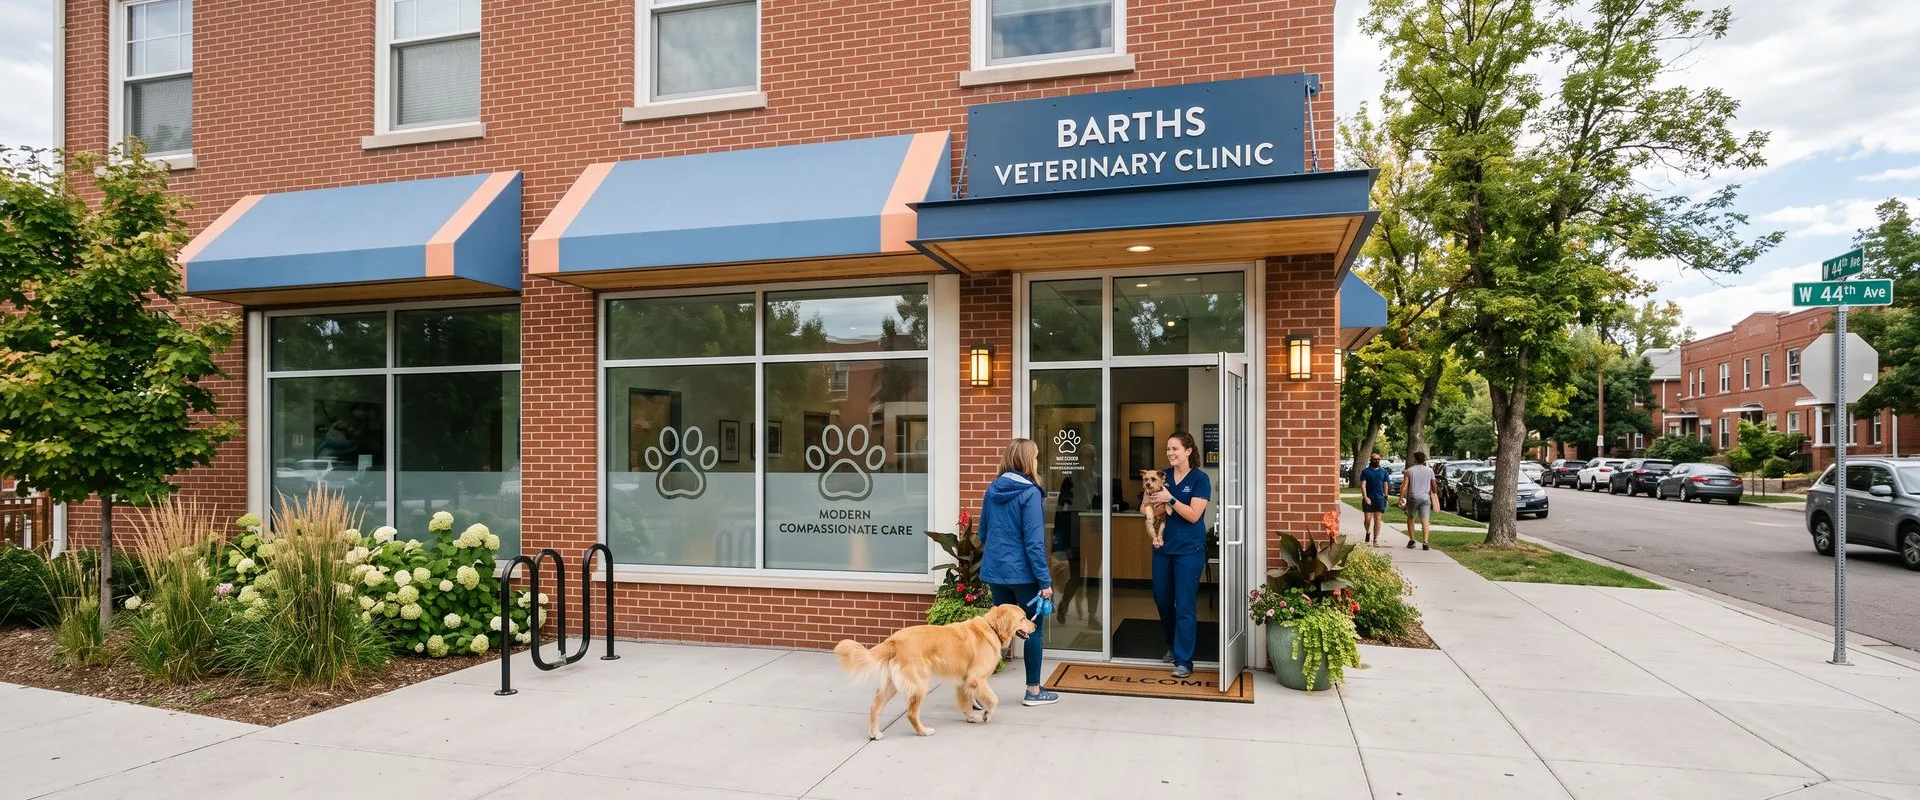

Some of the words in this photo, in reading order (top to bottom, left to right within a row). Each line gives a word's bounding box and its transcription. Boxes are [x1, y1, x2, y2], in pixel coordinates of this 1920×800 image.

[1057, 106, 1207, 148] BARTHS
[994, 151, 1167, 186] VETERINARY
[1174, 142, 1275, 172] CLINIC
[1824, 265, 1829, 280] W
[1831, 258, 1848, 276] 44th
[1850, 256, 1860, 268] Ave
[1799, 286, 1812, 302] W
[1820, 285, 1856, 302] 44th
[1864, 286, 1886, 298] Ave
[819, 509, 871, 520] MODERN
[779, 523, 878, 535] COMPASSIONATE
[880, 525, 913, 536] CARE
[1084, 674, 1219, 688] WELCOME
